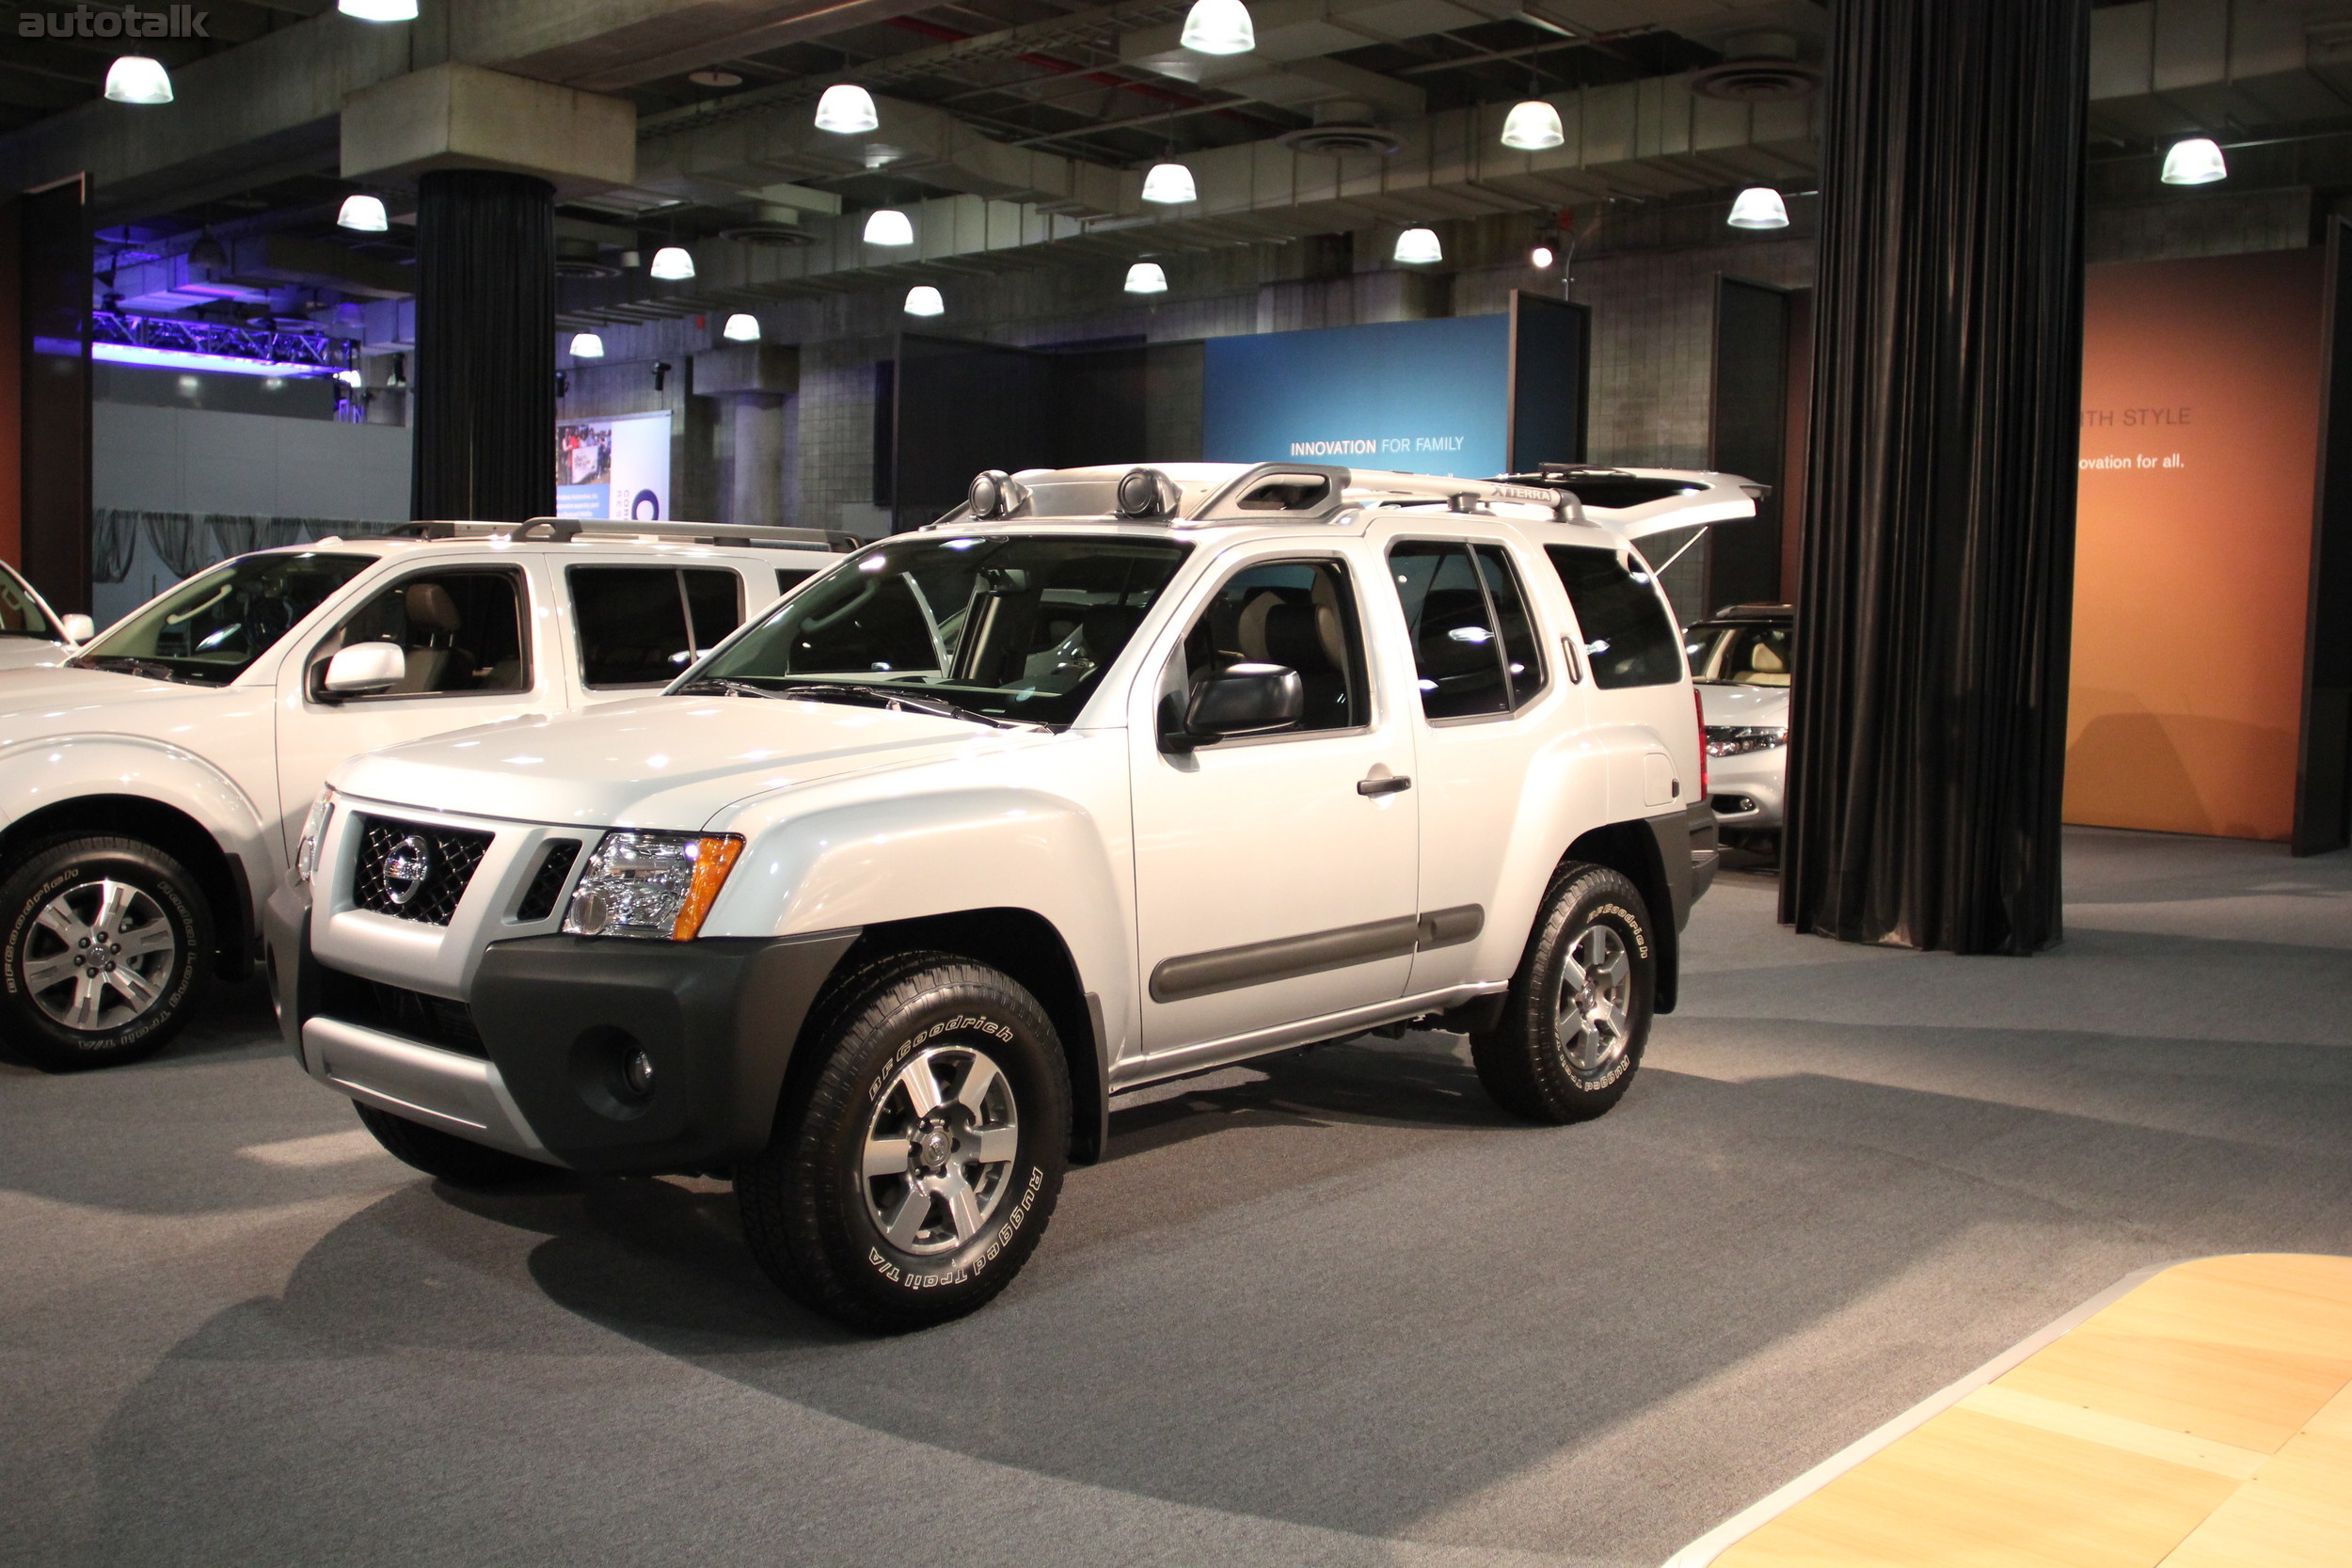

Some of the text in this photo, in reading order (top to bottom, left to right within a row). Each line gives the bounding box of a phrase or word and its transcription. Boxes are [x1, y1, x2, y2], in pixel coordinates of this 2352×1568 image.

[2123, 407, 2192, 426] STYLE
[1291, 436, 1465, 456] INNOVATION FOR FAMILY
[2078, 453, 2185, 469] ovation for all.
[1491, 485, 1551, 501] XTERRA
[5, 868, 79, 993] BFGoodrich
[1587, 903, 1648, 959] BFGoodrich
[869, 1014, 1014, 1101] BFGoodrich
[1584, 1054, 1630, 1092] Rugged
[868, 1166, 1043, 1290] Rugged Trail T/A
